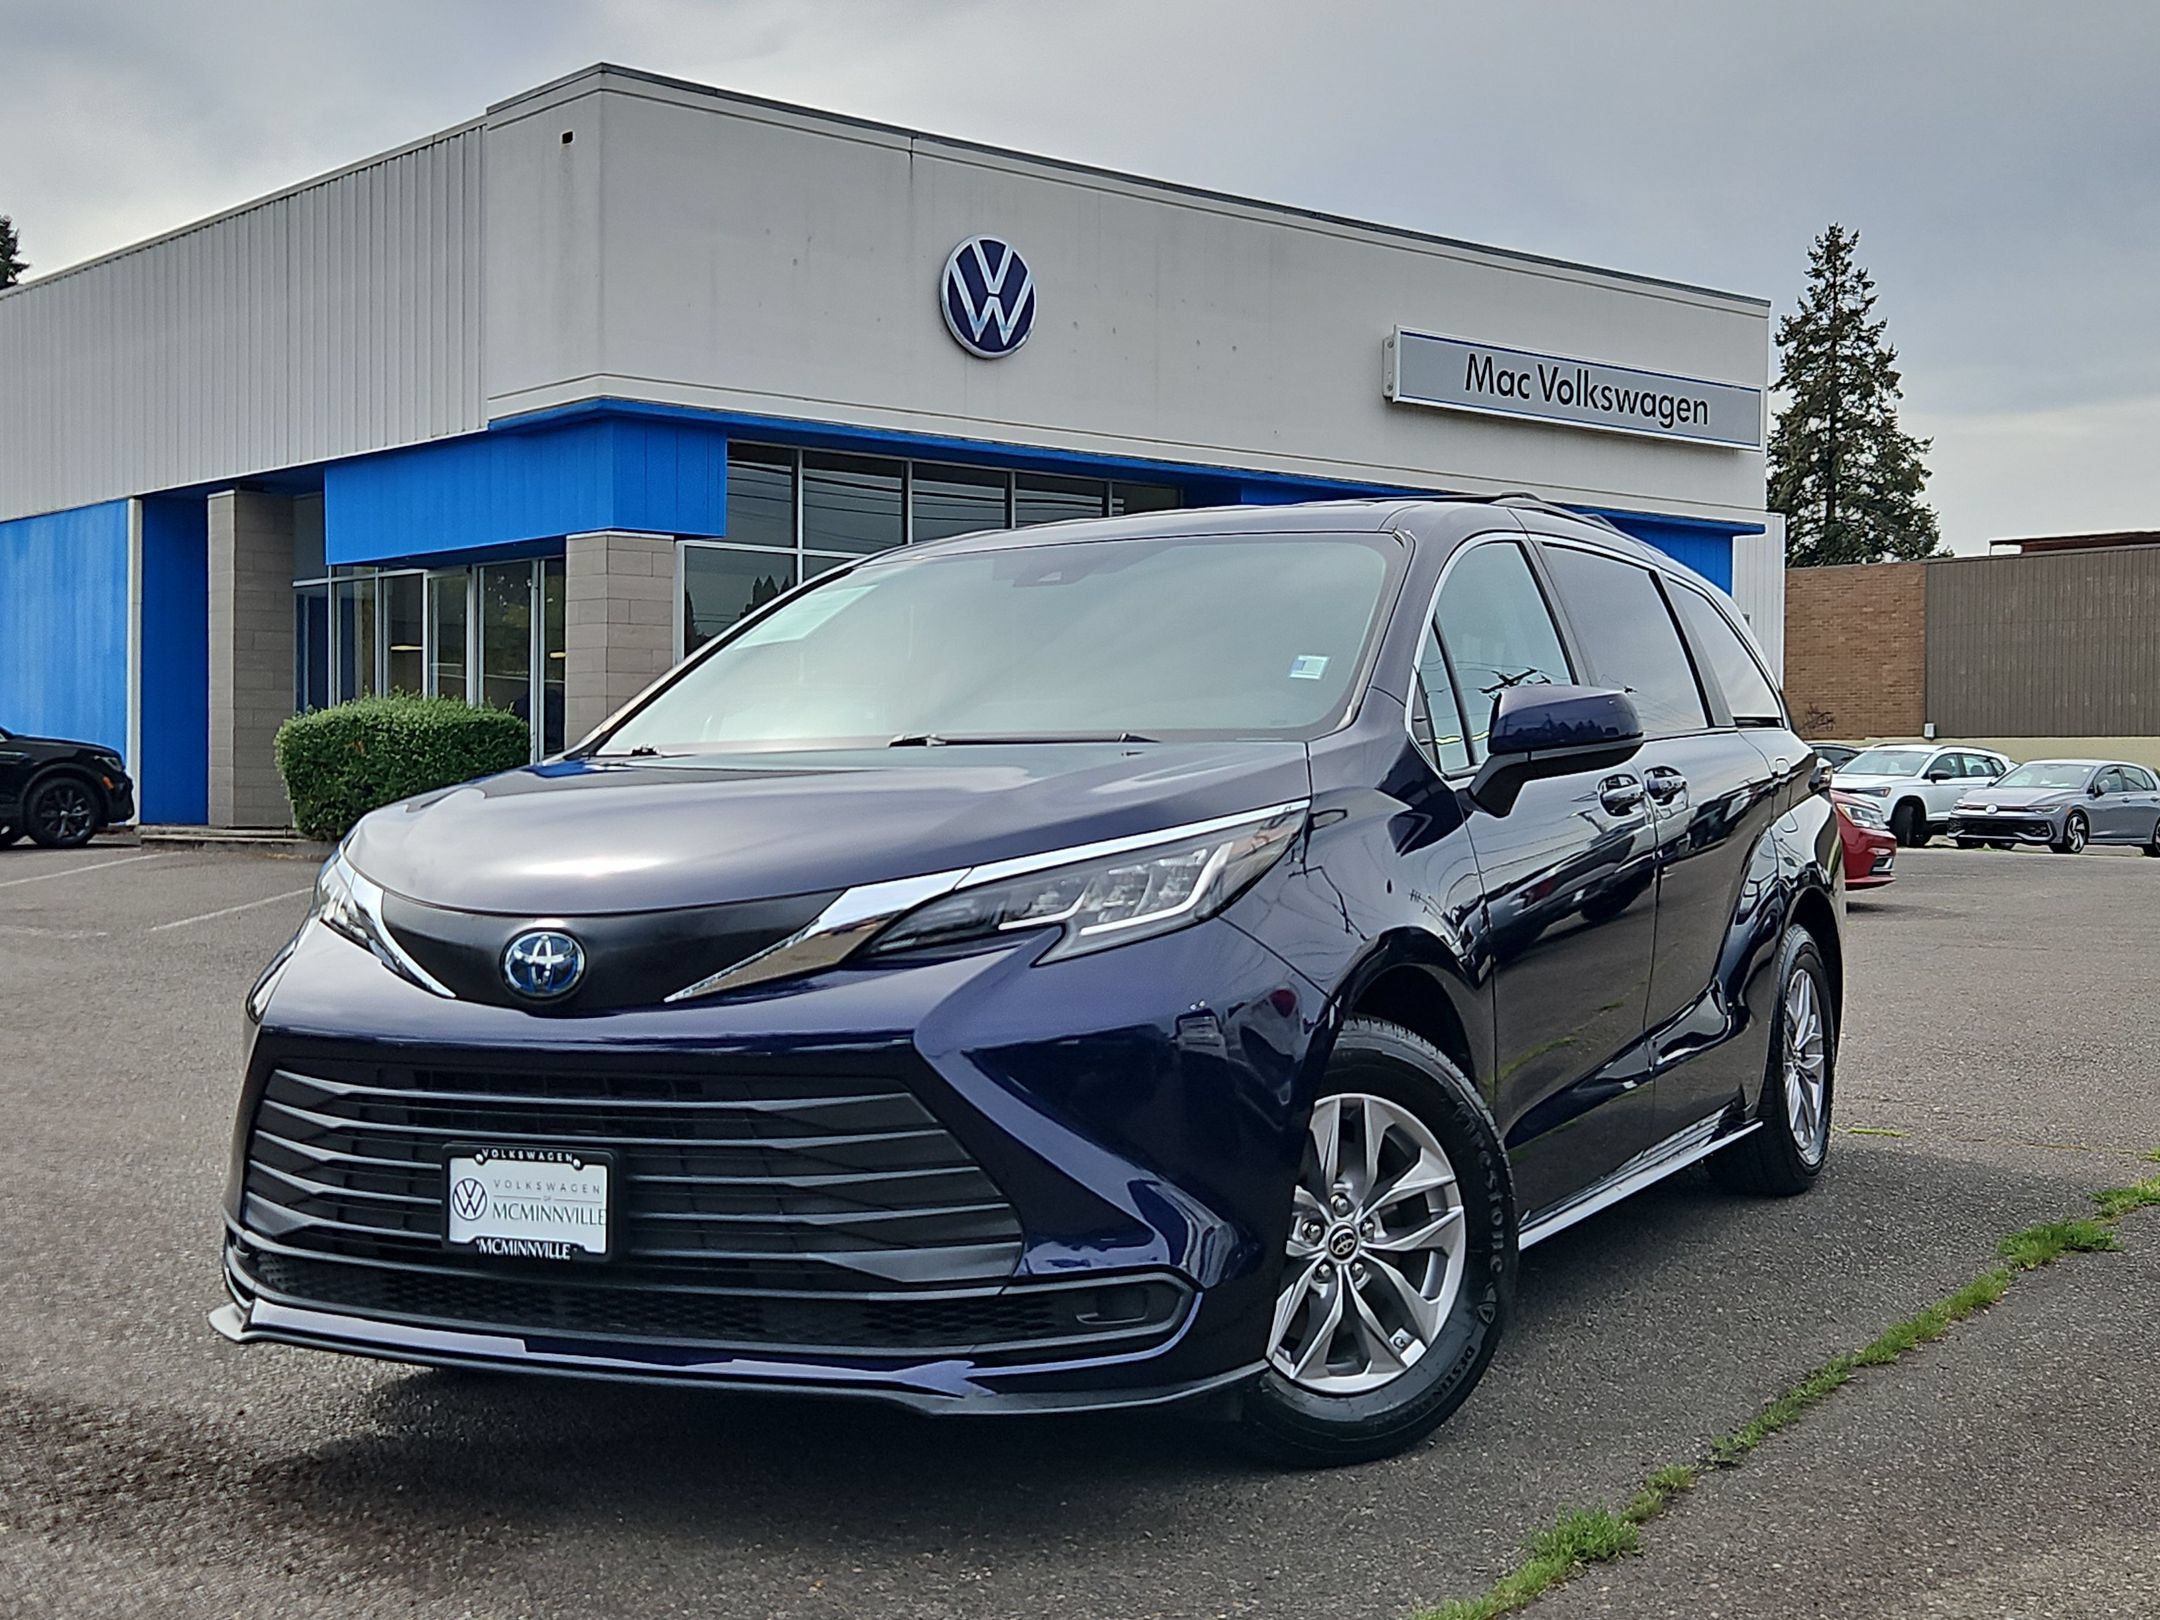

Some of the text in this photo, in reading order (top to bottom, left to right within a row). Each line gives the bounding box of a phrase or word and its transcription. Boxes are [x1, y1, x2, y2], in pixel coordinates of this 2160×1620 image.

[1465, 353, 1709, 429] Mac Volkswagen
[481, 1149, 573, 1163] VOLKSWAGEN
[493, 1180, 601, 1195] VOLKSWAGEN
[493, 1202, 607, 1226] MCMINNVILLE
[478, 1238, 571, 1260] MCMINNVILLE
